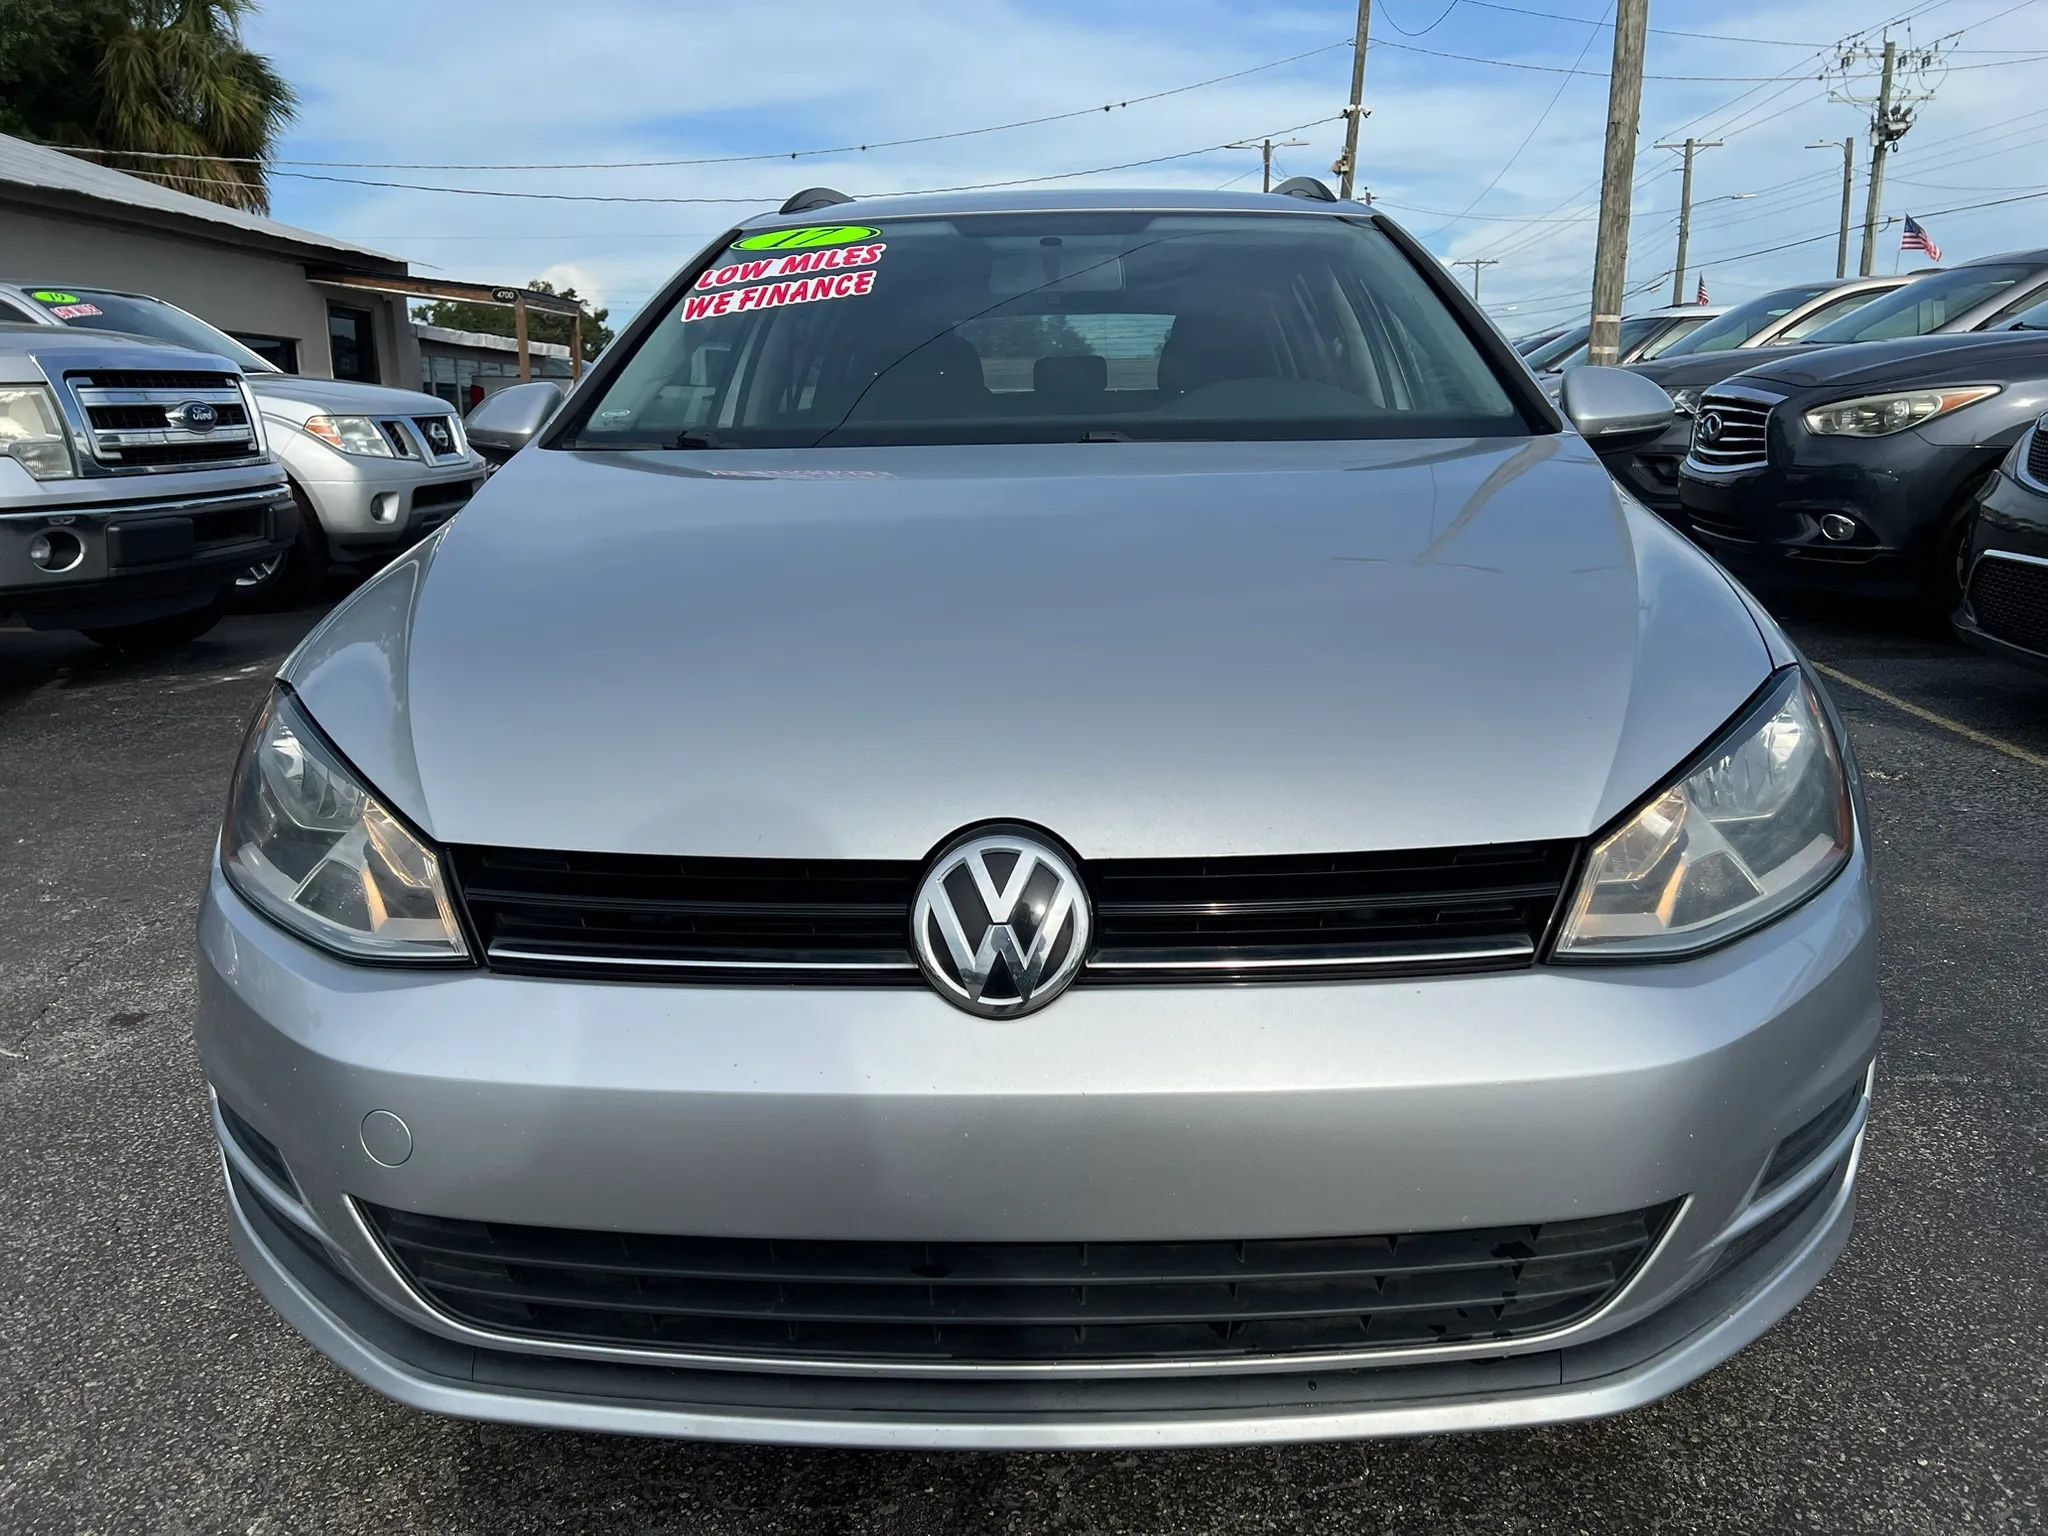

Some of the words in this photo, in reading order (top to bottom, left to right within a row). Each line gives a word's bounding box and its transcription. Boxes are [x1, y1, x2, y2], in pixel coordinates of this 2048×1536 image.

[771, 228, 845, 248] 17
[698, 260, 773, 289] LOW
[779, 244, 884, 275] MILES
[497, 291, 514, 299] 4700
[685, 292, 734, 320] WE
[738, 271, 874, 310] FINANCE
[192, 406, 213, 420] Ford
